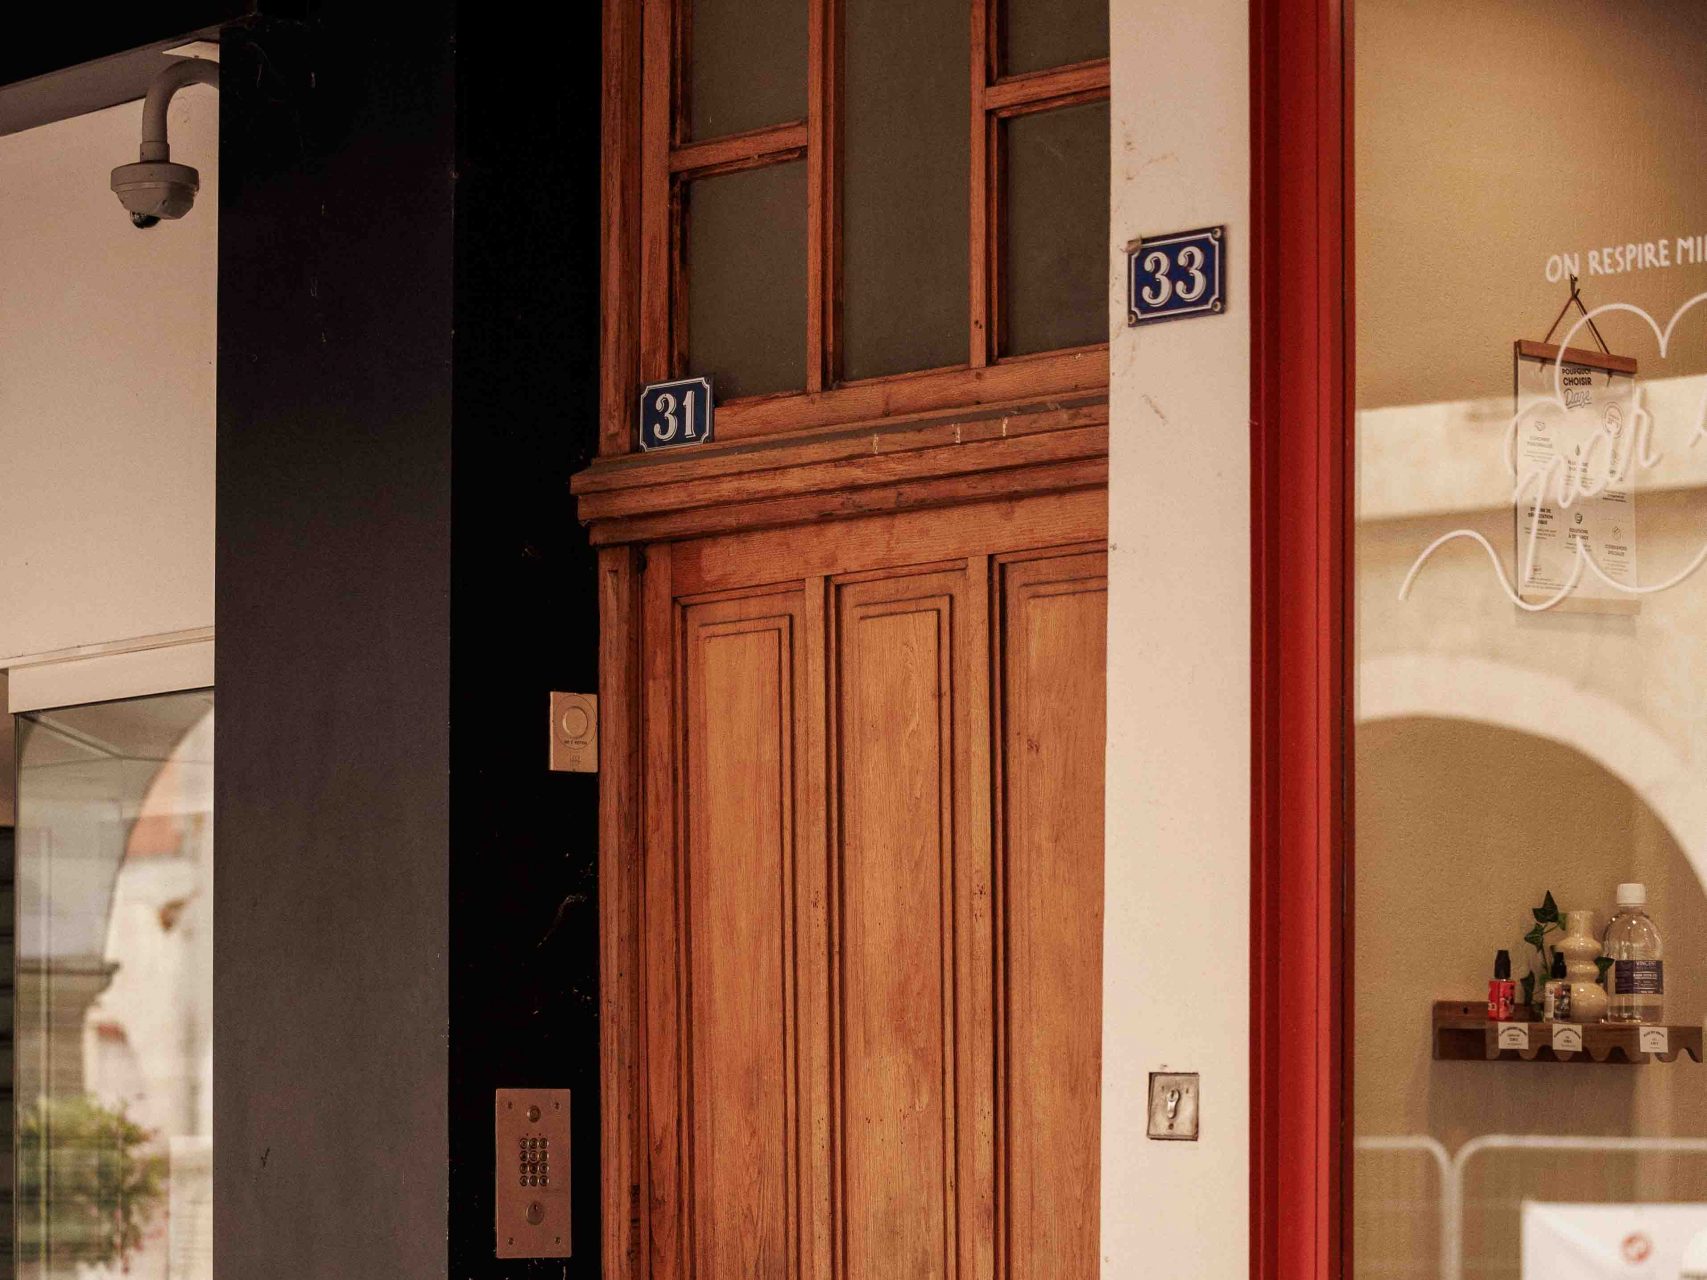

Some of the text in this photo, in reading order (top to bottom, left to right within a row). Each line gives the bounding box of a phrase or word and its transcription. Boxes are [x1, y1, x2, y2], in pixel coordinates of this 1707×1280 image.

[1142, 246, 1206, 307] 33
[1545, 252, 1580, 283] ON
[1588, 239, 1671, 276] RESPIRE
[1563, 377, 1592, 386] CHOISIR
[653, 390, 696, 441] 31
